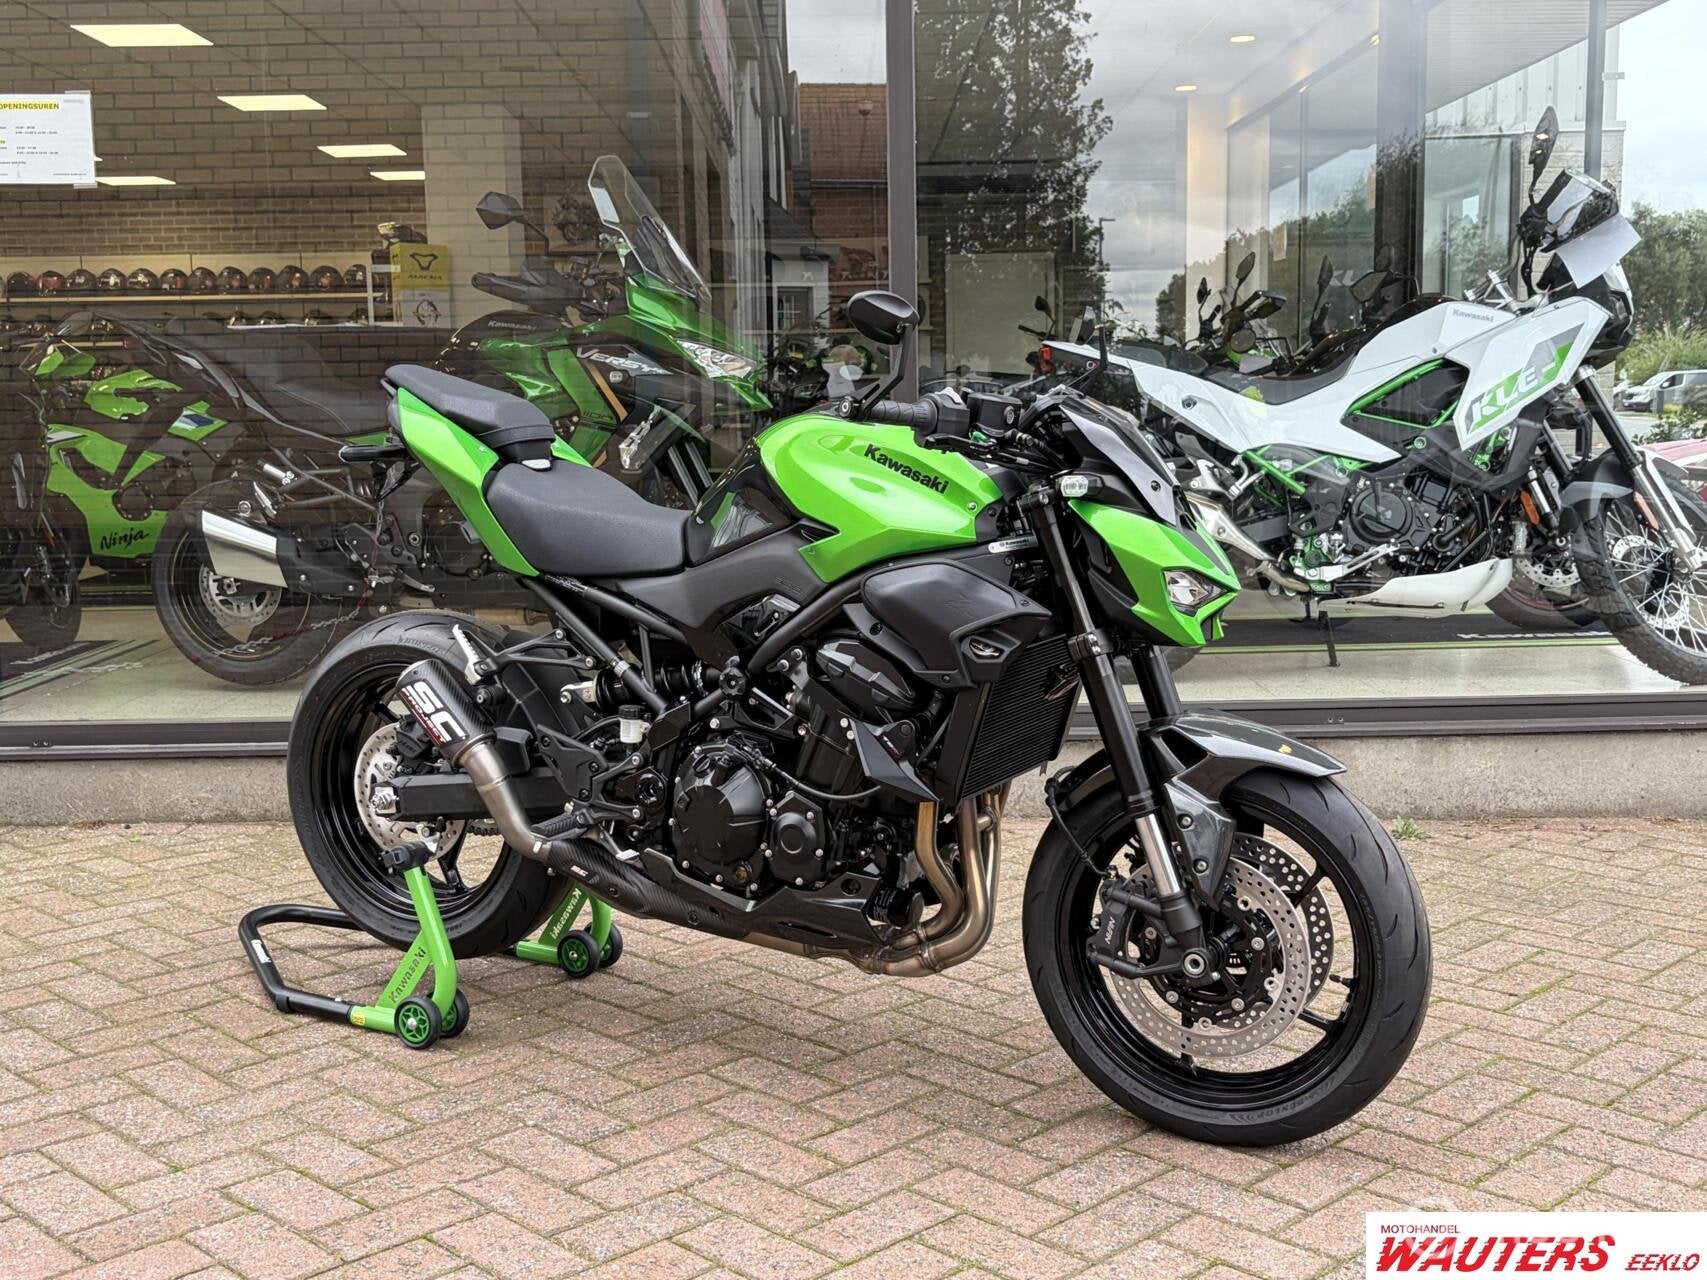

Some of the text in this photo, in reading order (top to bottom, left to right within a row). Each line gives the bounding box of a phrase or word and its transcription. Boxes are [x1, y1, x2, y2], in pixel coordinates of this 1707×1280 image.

[1452, 309, 1494, 322] Kawasaki
[864, 443, 950, 495] Kawasaki
[100, 527, 150, 550] Ninja
[388, 946, 427, 1003] Kawasaki
